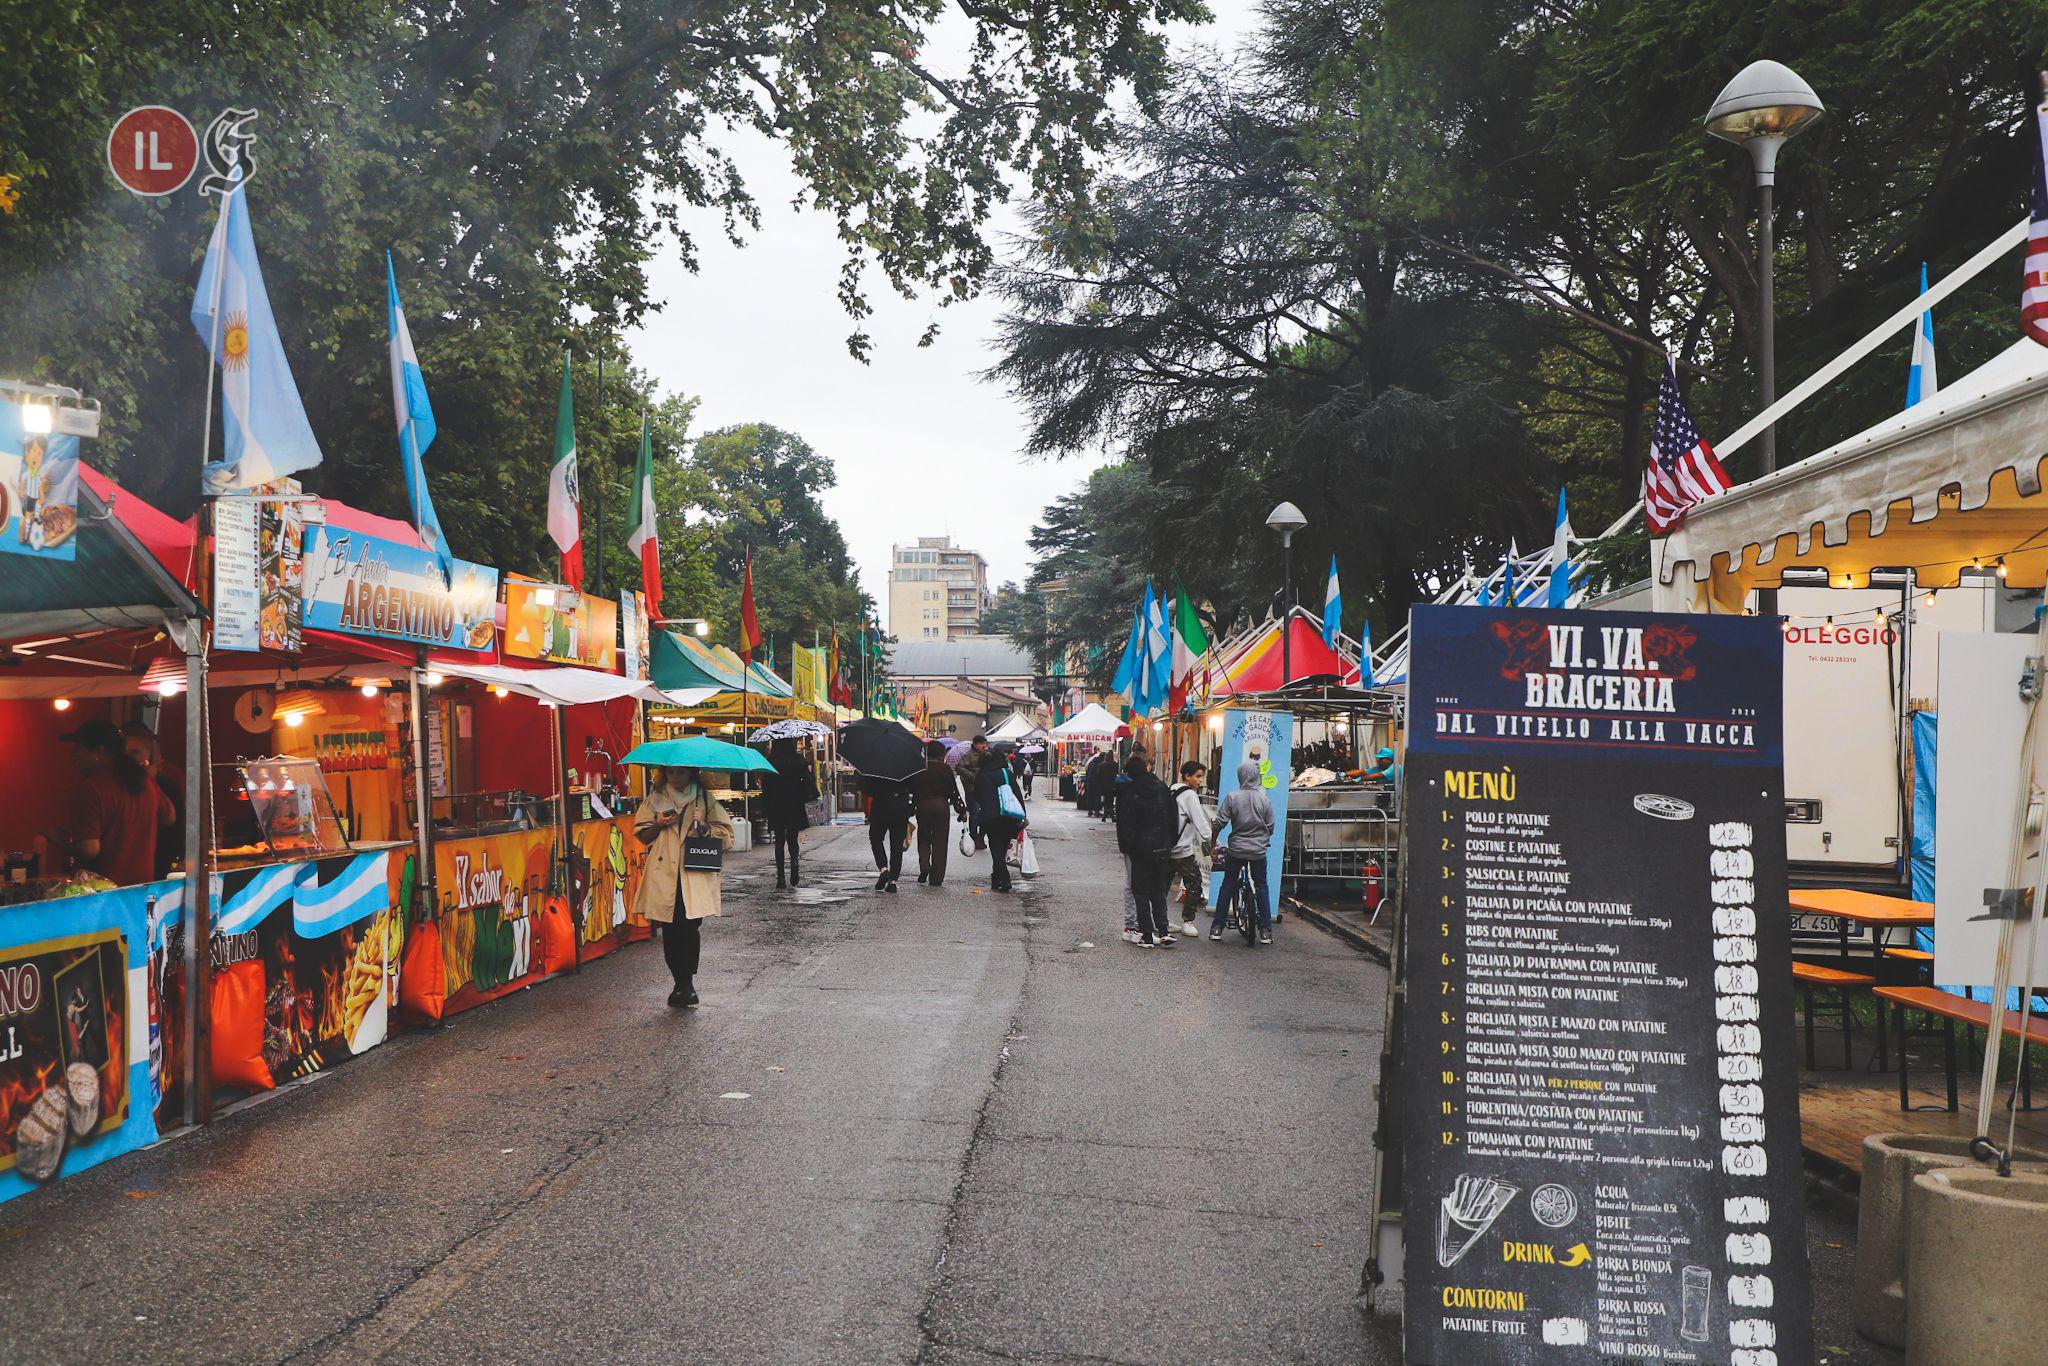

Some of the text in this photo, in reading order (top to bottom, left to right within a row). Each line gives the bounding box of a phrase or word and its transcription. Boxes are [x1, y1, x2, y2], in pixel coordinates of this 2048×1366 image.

[339, 579, 454, 641] ARGENTINO
[1525, 673, 1675, 713] BRACERIA
[1067, 734, 1111, 742] AMERICAN
[1436, 713, 1753, 746] DAL VITELLO ALLA VACCA
[1445, 765, 1516, 801] MENÙ
[1465, 811, 1495, 824] POLLO
[1498, 813, 1503, 824] E
[1506, 813, 1549, 826] PATATINE
[690, 847, 718, 856] DOUGLAS
[1465, 839, 1505, 852] COSTINE
[1509, 841, 1514, 853] E
[1517, 842, 1560, 854] PATATINE
[455, 852, 502, 909] El sabor
[1465, 867, 1515, 881] SALSICCIA
[1518, 870, 1523, 881] E
[1526, 870, 1570, 884] PATATINE
[505, 879, 515, 915] de
[1465, 896, 1510, 910] TAGLIATA
[1512, 898, 1523, 910] DI
[1526, 899, 1562, 912] PICAÑA
[1565, 901, 1585, 913] CON
[1588, 902, 1632, 915] PATATINE
[1441, 924, 1558, 940] 5 RIBS CON PATATINE
[1465, 954, 1510, 967] TAGLIATA
[1513, 957, 1524, 968] DI
[1527, 957, 1587, 971] DIAFRAMMA
[1590, 960, 1610, 972] CON
[1613, 962, 1657, 974] PATATINE
[1466, 983, 1515, 997] GRIGLIATA
[1518, 986, 1548, 999] MISTA
[1551, 987, 1571, 1000] CON
[1574, 989, 1618, 1002] PATATINE
[1466, 1012, 1516, 1026] GRIGLIATA
[1518, 1015, 1549, 1028] MISTA
[1552, 1017, 1557, 1028] E
[1560, 1017, 1595, 1030] MANZO
[1598, 1019, 1618, 1031] CON
[1622, 1020, 1666, 1034] PATATINE
[1466, 1042, 1516, 1056] GRIGLIATA
[1519, 1045, 1549, 1058] MISTA
[1552, 1047, 1576, 1059] SOLO
[1580, 1048, 1614, 1061] MANZO
[1617, 1050, 1638, 1062] CON
[1641, 1051, 1686, 1065] PATATINE
[1466, 1071, 1516, 1085] GRIGLIATA
[1519, 1075, 1529, 1086] VI
[1532, 1076, 1545, 1087] VA
[1548, 1079, 1562, 1088] PER
[1564, 1079, 1568, 1089] 2
[1570, 1080, 1602, 1090] PERSONE
[1604, 1081, 1619, 1092] CON
[1624, 1083, 1657, 1093] PATATINE
[1466, 1102, 1572, 1118] FIORENTINA/COSTATA
[1575, 1108, 1595, 1120] CON
[1598, 1109, 1644, 1122] PATATINE
[1468, 1132, 1521, 1146] TOMAHAWK
[1524, 1135, 1544, 1147] CON
[1548, 1137, 1593, 1150] PATATINE
[1594, 1185, 1628, 1200] ACQUA
[1596, 1215, 1632, 1230] BIBITE
[1596, 1231, 1612, 1240] Coca
[1503, 1241, 1555, 1265] DRINK
[1596, 1257, 1672, 1273] BIRRA BIONDA
[1443, 1286, 1525, 1311] CONTORNI
[1598, 1299, 1665, 1315] BIRRA ROSSA
[1443, 1318, 1526, 1334] PATATINE FRITTE
[1598, 1341, 1624, 1355] VINO
[1627, 1343, 1659, 1357] ROSSO
